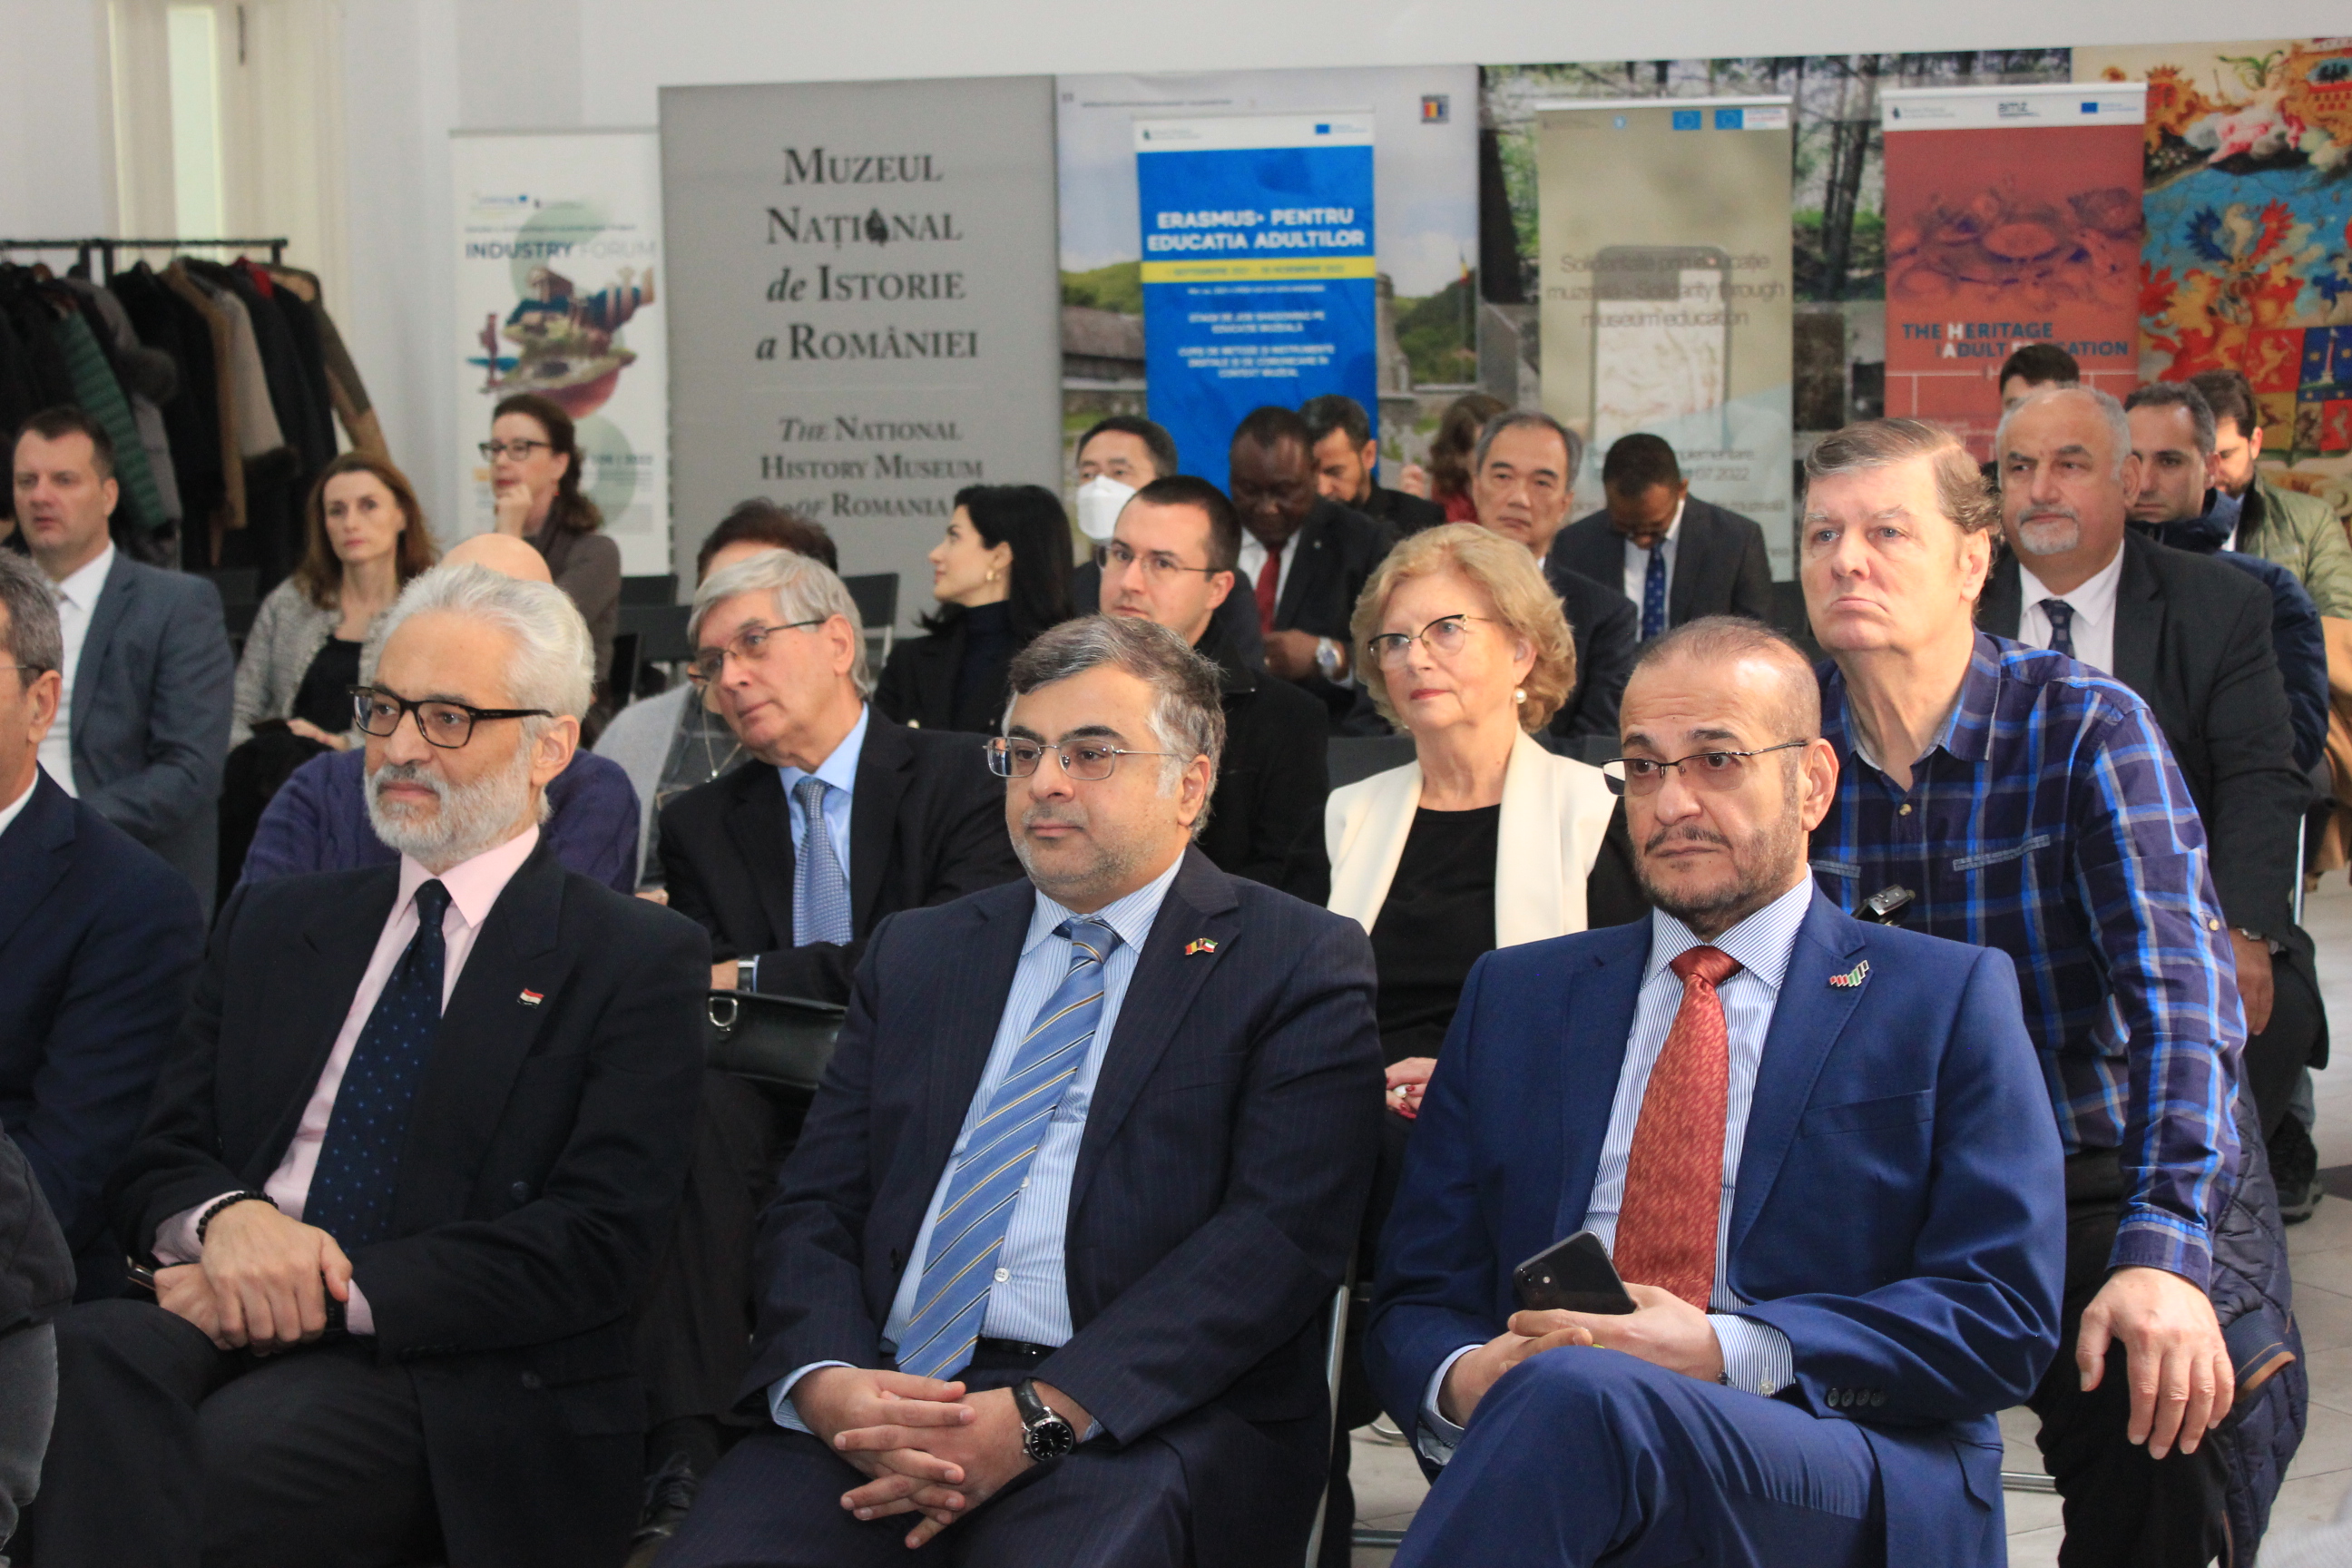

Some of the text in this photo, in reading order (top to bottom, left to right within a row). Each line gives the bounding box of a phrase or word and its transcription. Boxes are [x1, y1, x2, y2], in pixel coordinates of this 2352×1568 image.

[783, 147, 944, 184] MUZEUL
[1270, 208, 1354, 226] PENTRU
[466, 241, 657, 260] INDUSTRY FORUM
[766, 264, 966, 302] de ISTORIE
[756, 322, 978, 360] a ROMÂNIEI
[1902, 322, 2053, 340] THE HERITAGE
[1942, 341, 2008, 359] ADULT
[779, 415, 964, 442] THE NATIONAL
[760, 454, 985, 479] HISTORY MUSEUM
[832, 492, 950, 517] ROMANIA
